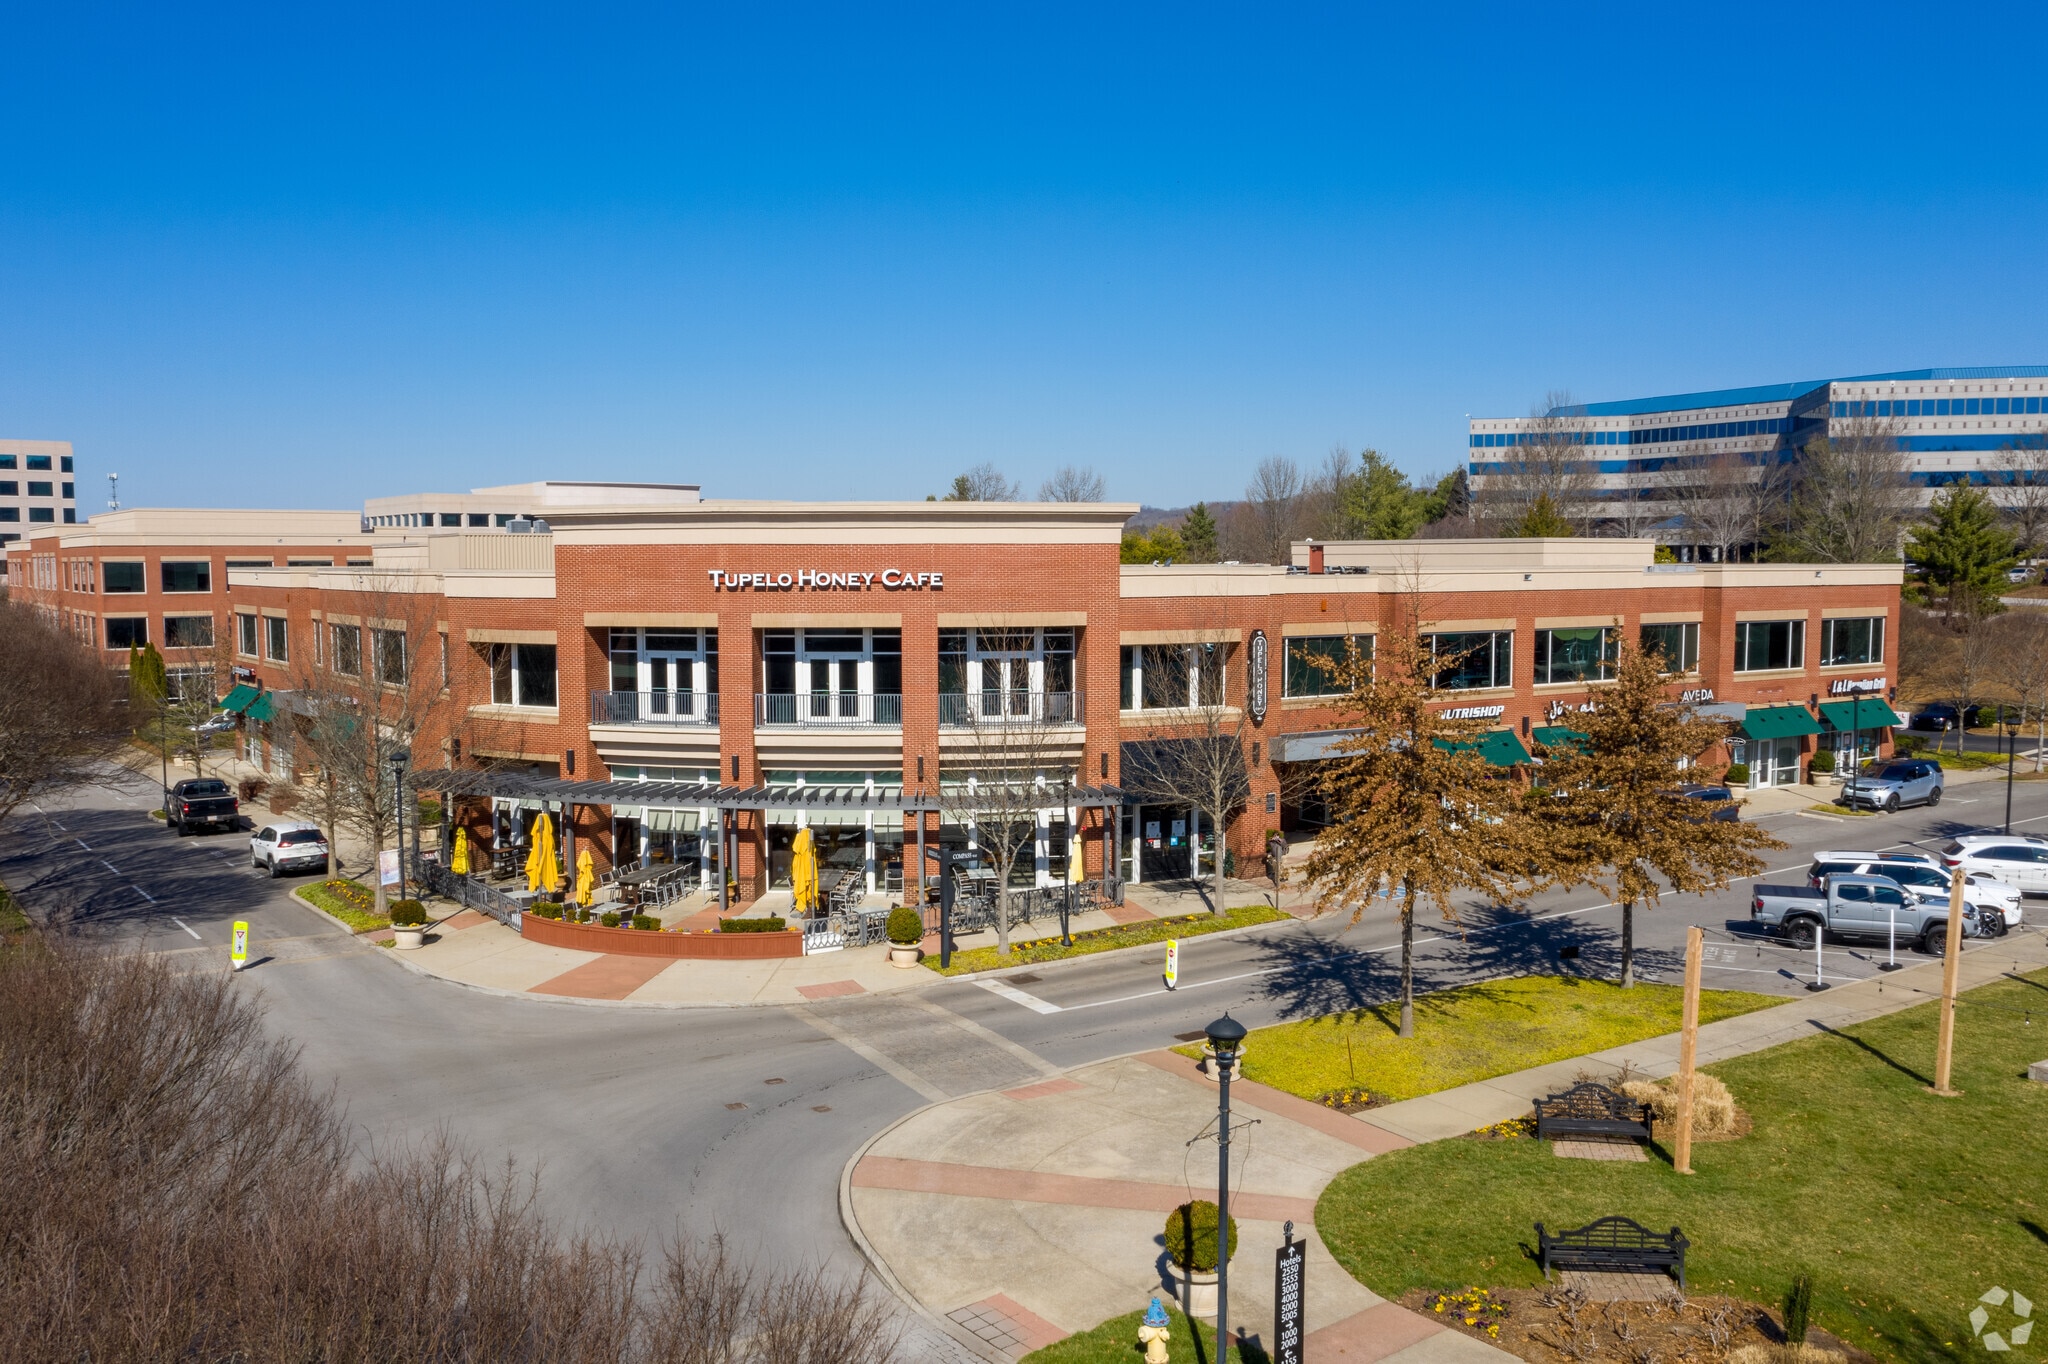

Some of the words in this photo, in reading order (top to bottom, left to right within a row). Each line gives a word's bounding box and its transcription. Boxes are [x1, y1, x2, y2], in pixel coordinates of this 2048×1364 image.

[708, 570, 793, 587] TUPELO
[798, 569, 875, 586] HONEY
[881, 568, 944, 586] CAFE
[1682, 689, 1714, 702] AVEDA
[1280, 1254, 1302, 1269] Hotels
[1282, 1264, 1299, 1277] 2550
[1282, 1274, 1298, 1286] 2555
[1281, 1282, 1298, 1295] 3000
[1281, 1291, 1298, 1304] 4000
[1281, 1300, 1298, 1313] 5000
[1281, 1309, 1298, 1322] 5005
[1281, 1327, 1298, 1340] 1000
[1281, 1336, 1298, 1350] 2000
